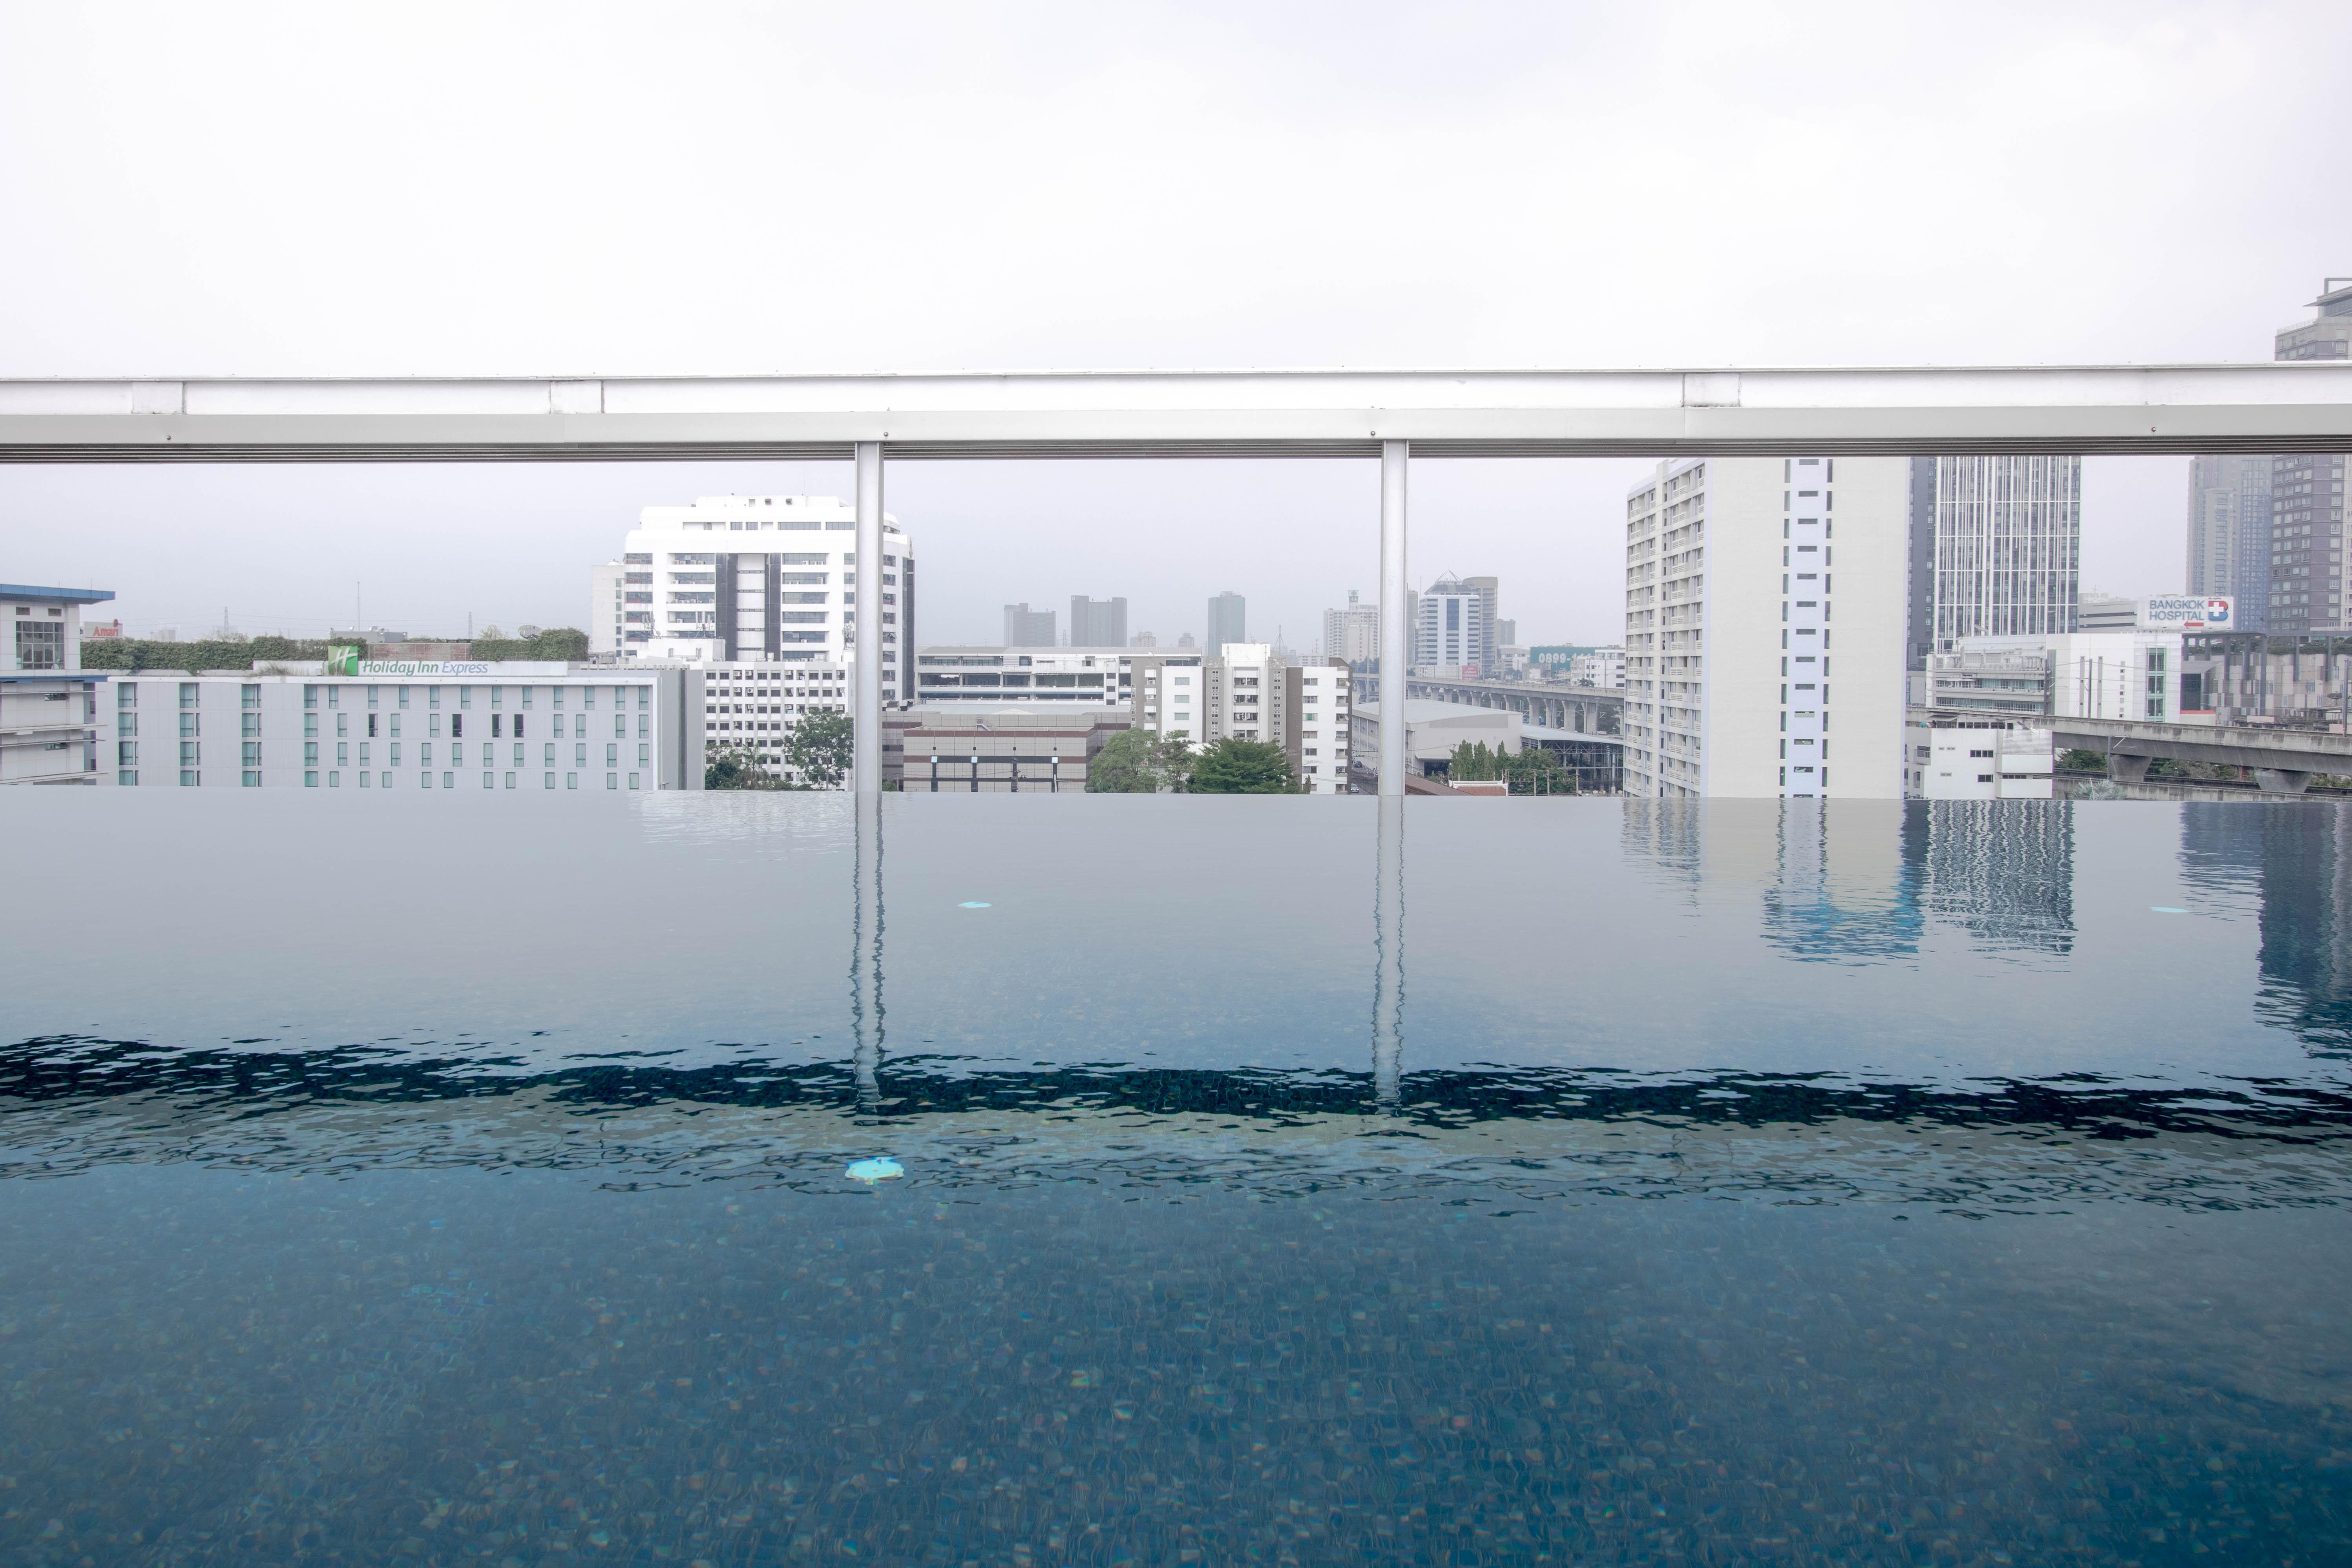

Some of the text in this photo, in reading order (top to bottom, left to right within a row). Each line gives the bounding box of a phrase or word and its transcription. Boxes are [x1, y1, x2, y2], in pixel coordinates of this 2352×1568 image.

[2149, 600, 2205, 609] BANGKOK
[2149, 611, 2204, 621] HOSPITAL
[363, 659, 489, 676] Holiday Inn Express
